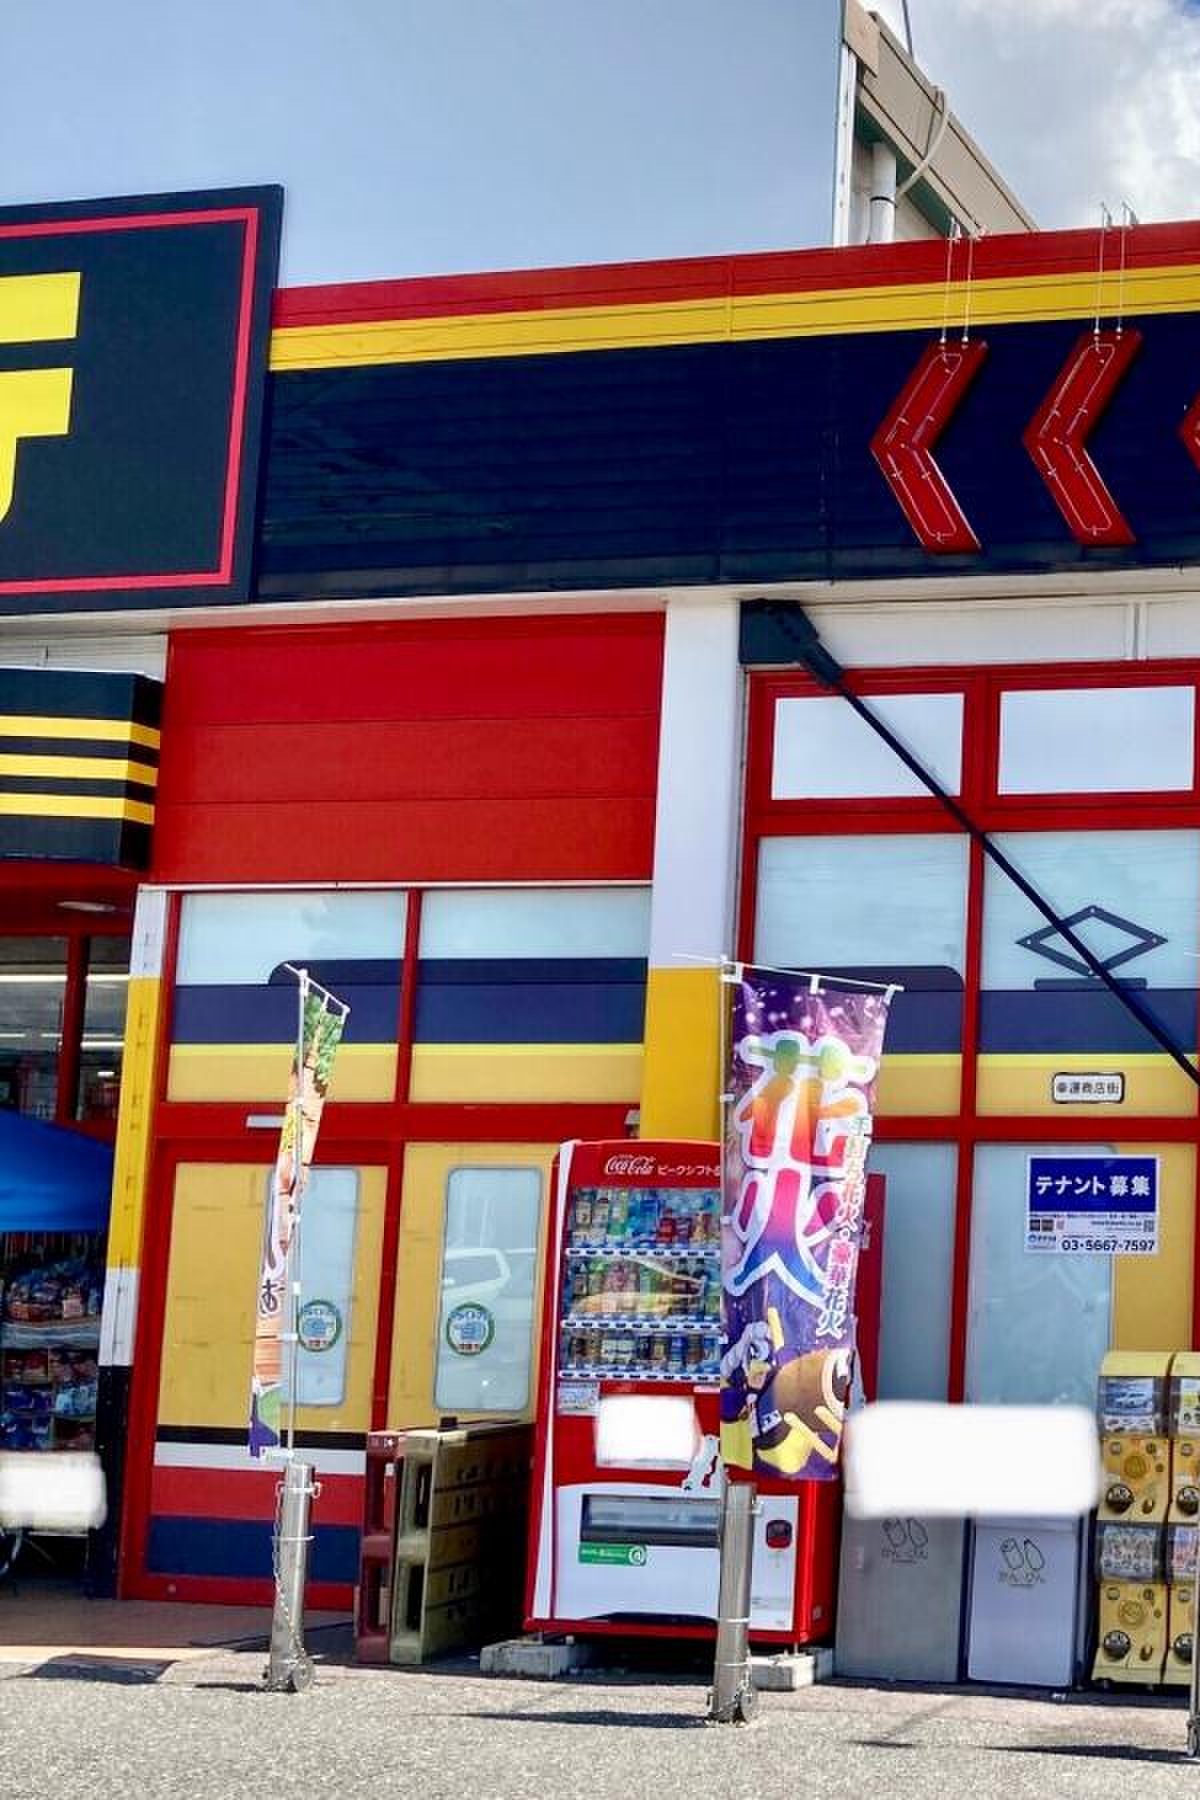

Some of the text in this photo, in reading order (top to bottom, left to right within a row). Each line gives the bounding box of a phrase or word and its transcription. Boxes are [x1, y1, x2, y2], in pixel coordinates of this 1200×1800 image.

[728, 1031, 876, 1307] 花火
[1036, 1175, 1151, 1197] テナント募集
